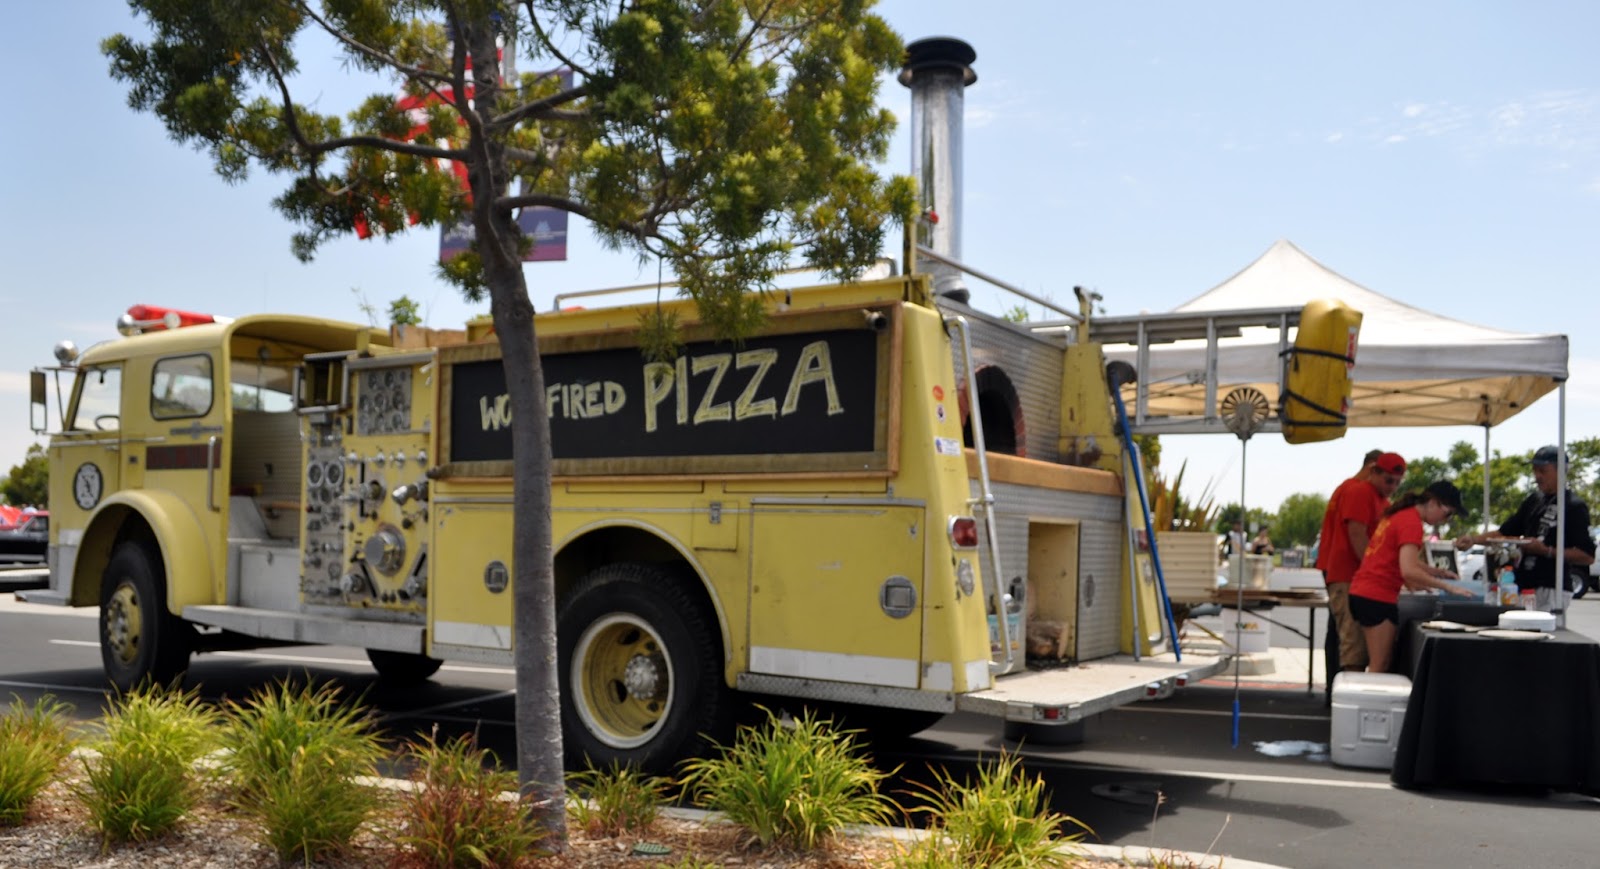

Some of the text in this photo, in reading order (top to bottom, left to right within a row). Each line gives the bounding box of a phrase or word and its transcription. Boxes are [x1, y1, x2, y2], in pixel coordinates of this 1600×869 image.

[479, 340, 844, 433] WO FIRED PIZZA
